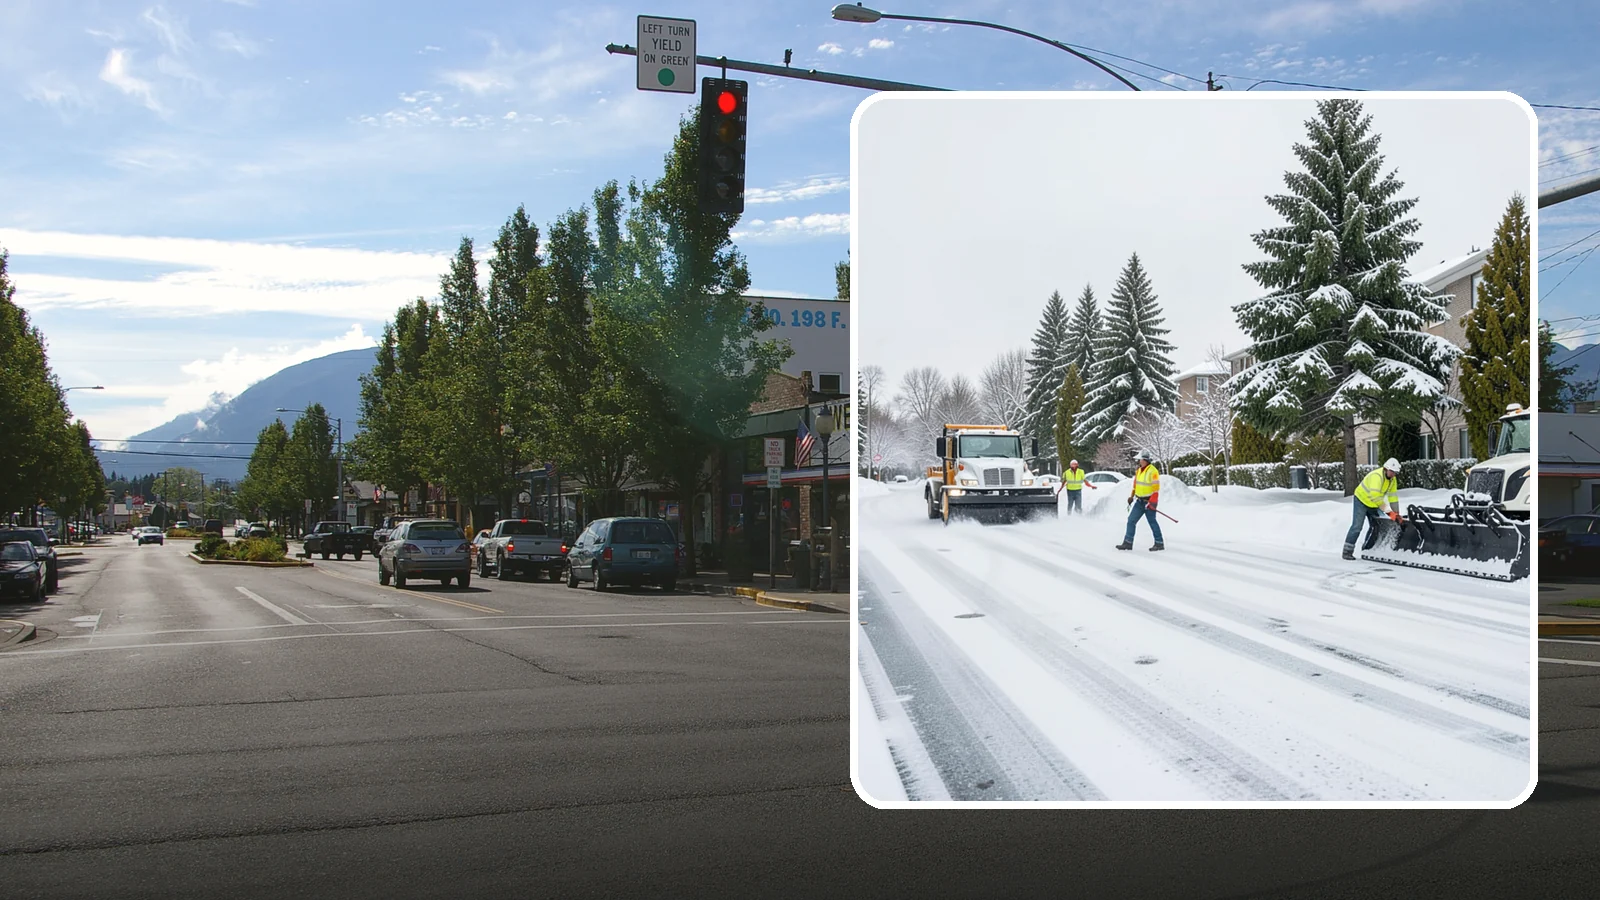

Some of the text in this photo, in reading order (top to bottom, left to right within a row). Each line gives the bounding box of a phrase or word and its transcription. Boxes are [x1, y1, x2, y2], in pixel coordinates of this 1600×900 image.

[643, 24, 690, 36] LEFT TURN
[652, 38, 682, 51] YIELD
[644, 53, 689, 66] ON GREEN
[762, 307, 786, 326] O.
[791, 309, 826, 327] 198
[831, 311, 846, 328] F.
